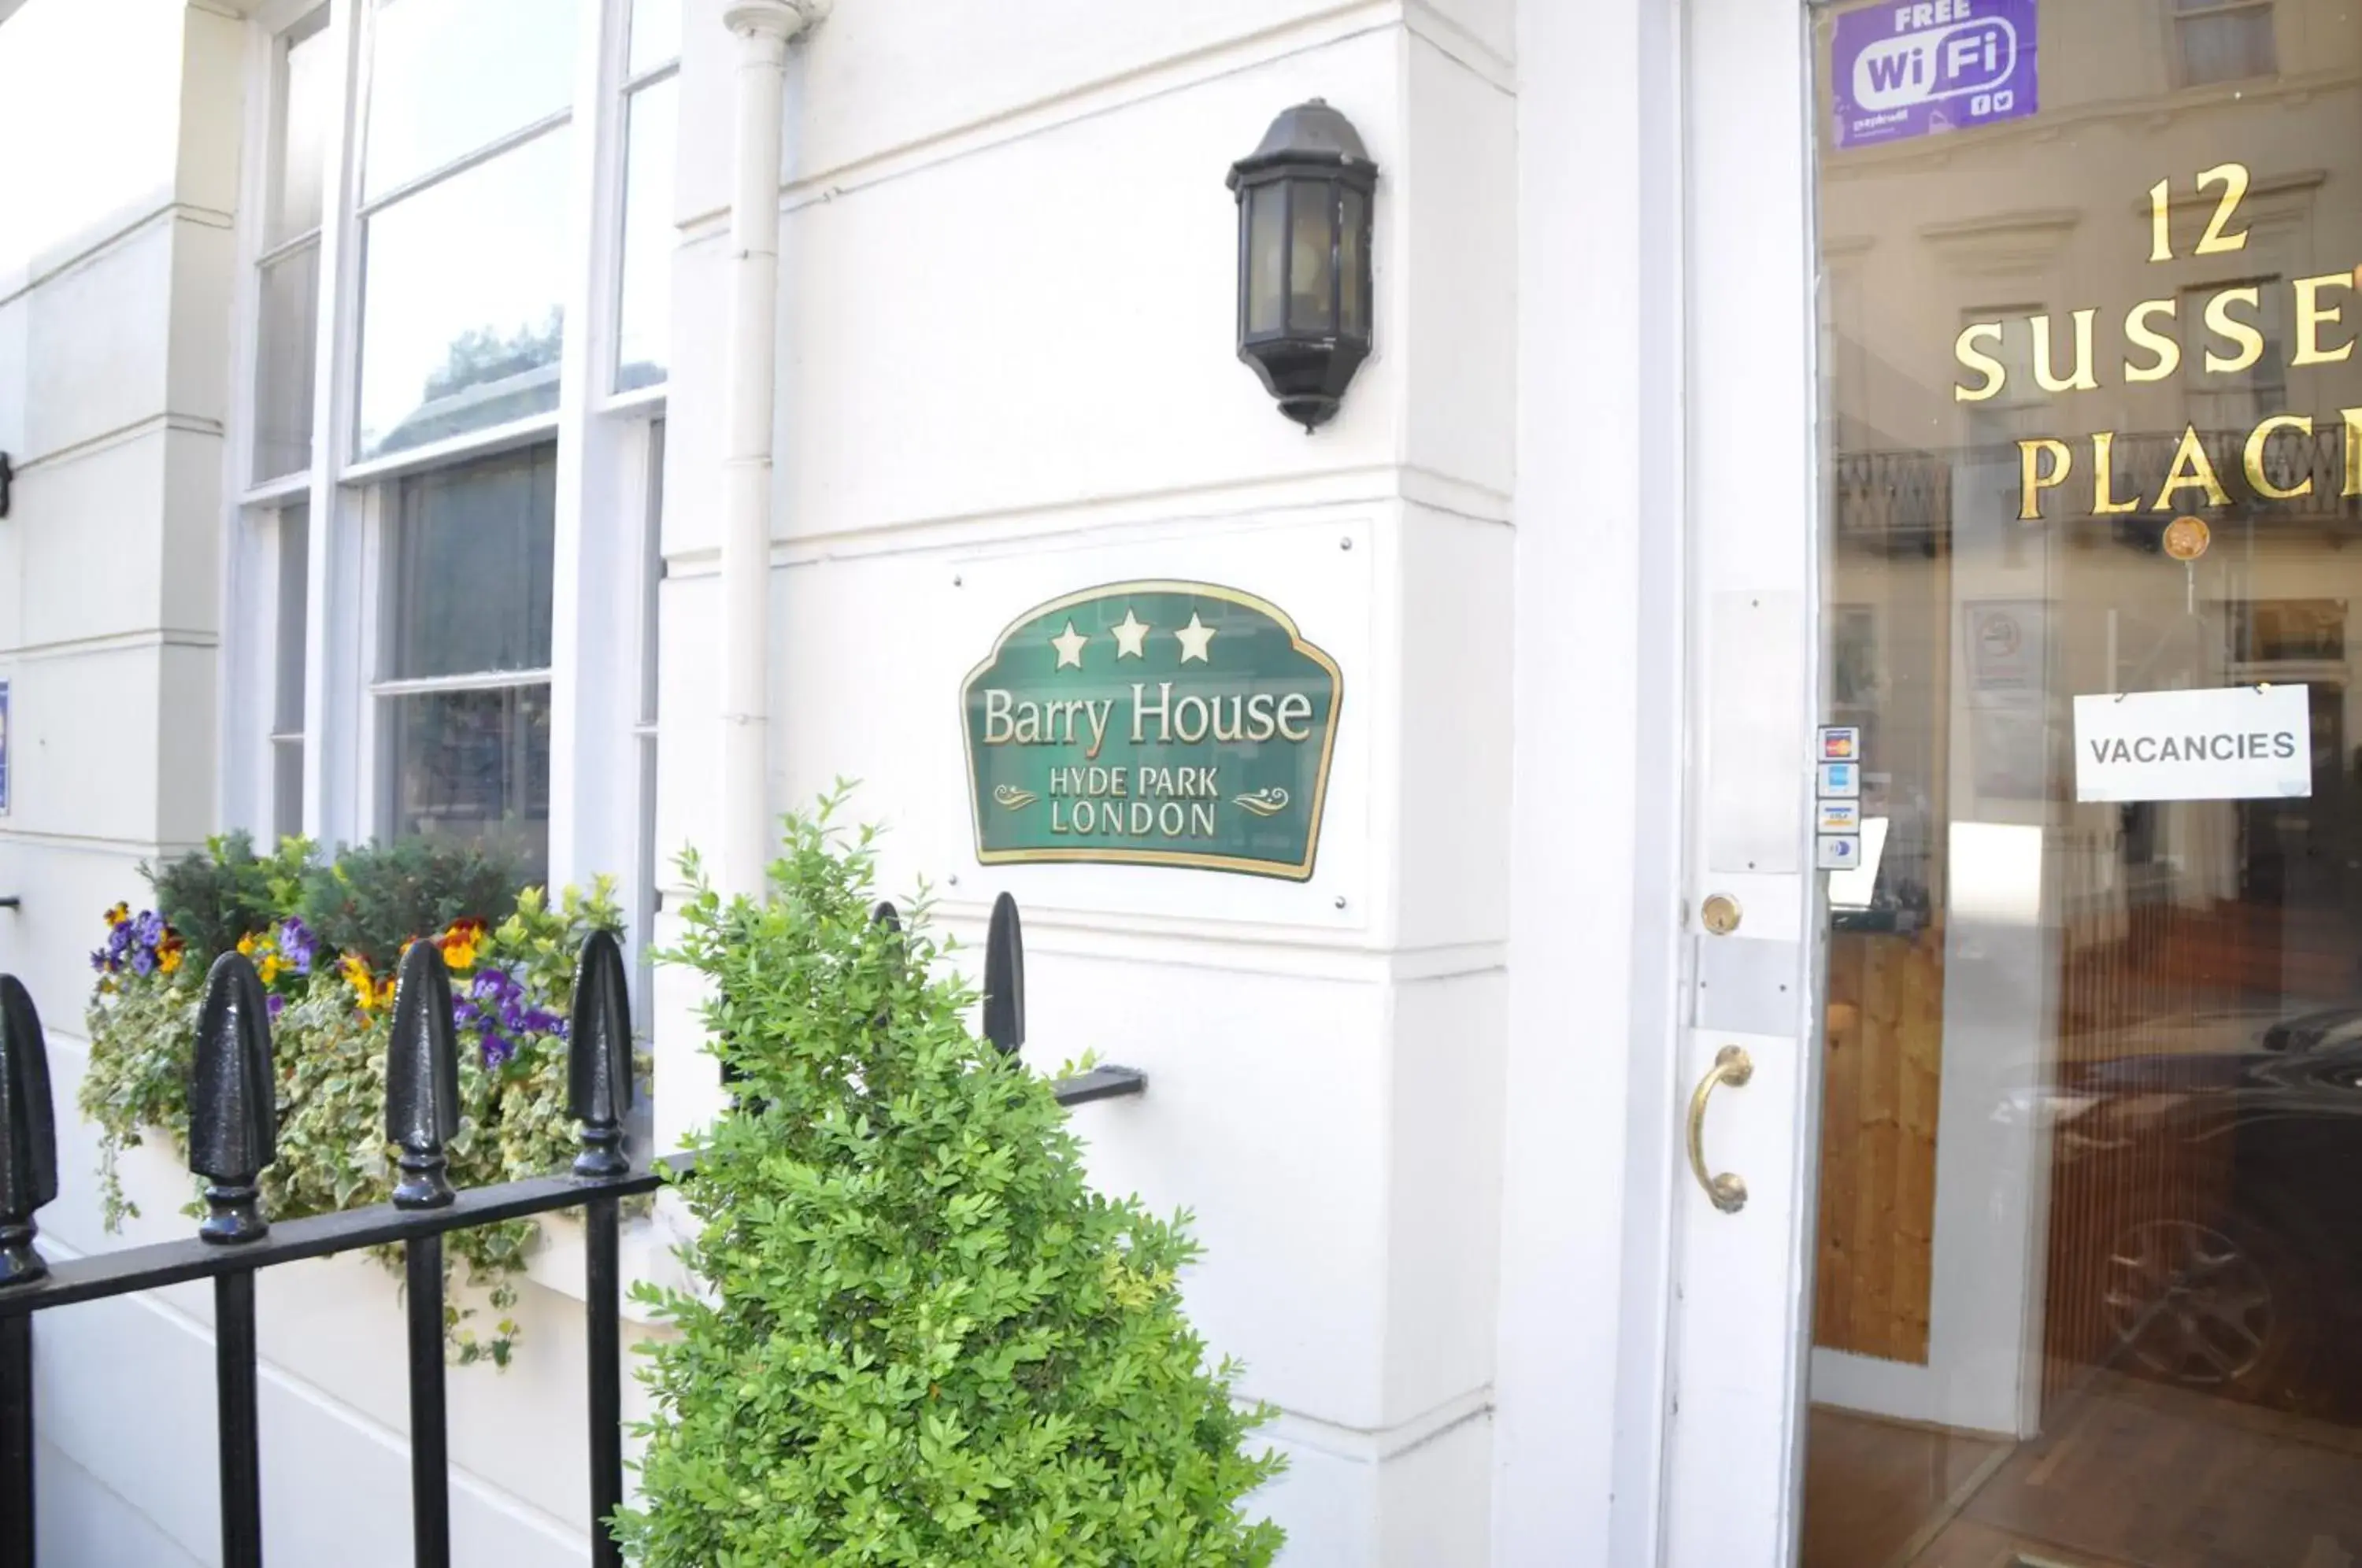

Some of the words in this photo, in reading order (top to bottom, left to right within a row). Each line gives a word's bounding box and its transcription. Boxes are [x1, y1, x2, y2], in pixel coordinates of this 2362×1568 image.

[1895, 0, 1971, 31] FREE
[2147, 162, 2252, 263] 12
[984, 688, 1115, 759] Barry
[1130, 682, 1313, 745] House
[2090, 731, 2296, 764] VACANCIES
[1050, 767, 1128, 798] HYDE
[1138, 766, 1220, 799] PARK
[1051, 801, 1217, 838] LONDON
